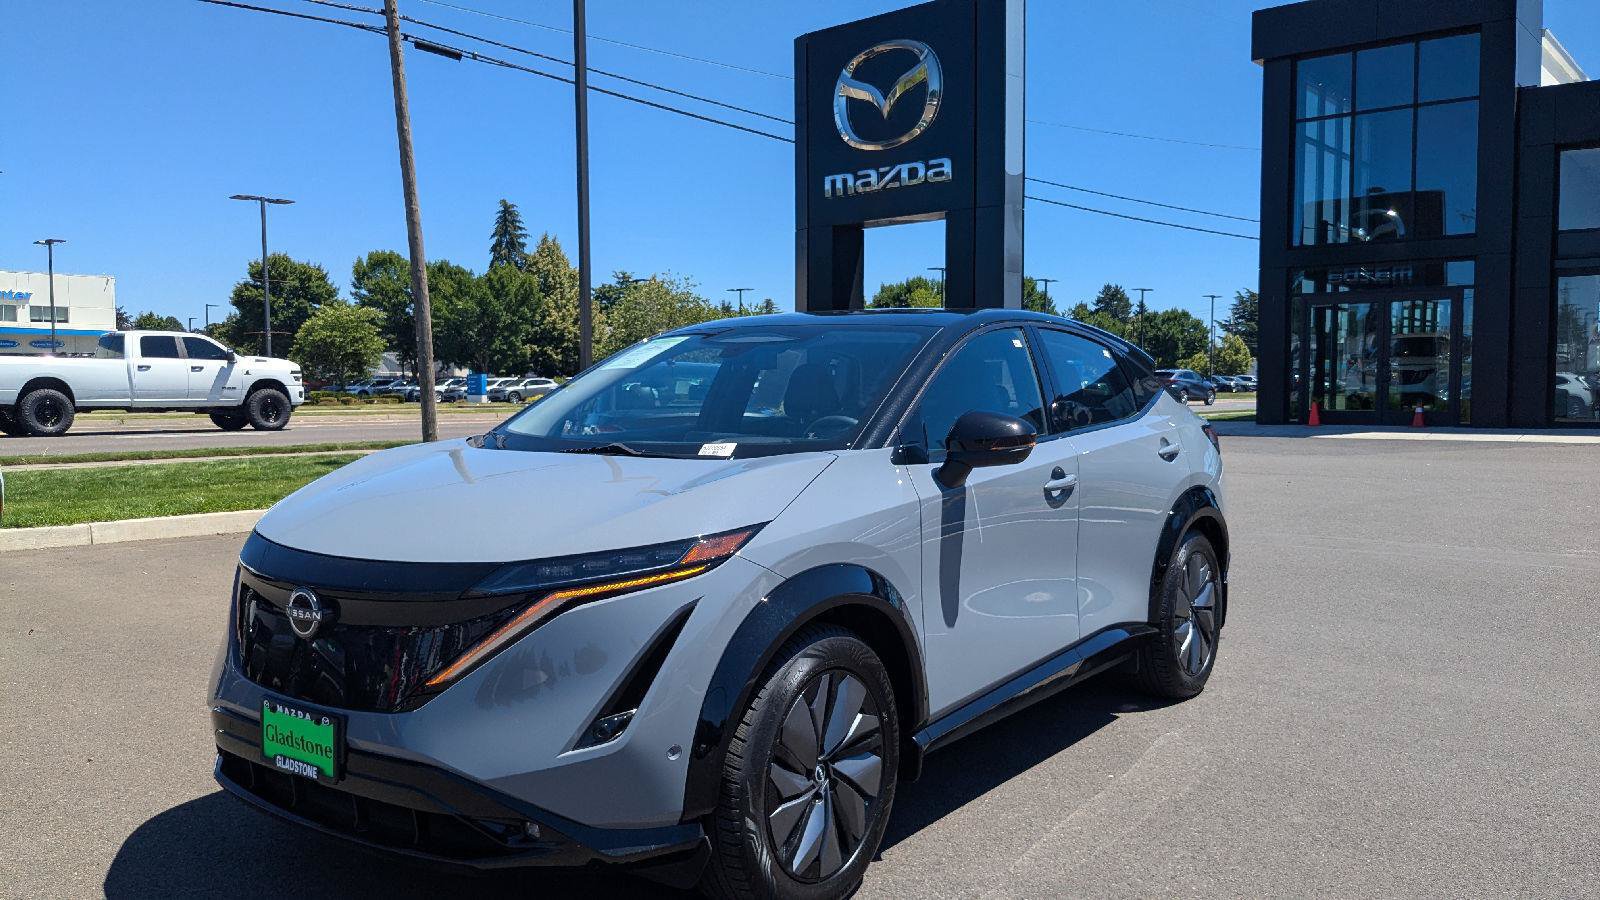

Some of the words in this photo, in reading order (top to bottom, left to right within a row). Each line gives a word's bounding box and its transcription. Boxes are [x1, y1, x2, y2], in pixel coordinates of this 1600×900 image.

[277, 704, 311, 721] MAZDA
[266, 723, 333, 759] Gladstone
[276, 756, 318, 779] GLADSTONE
